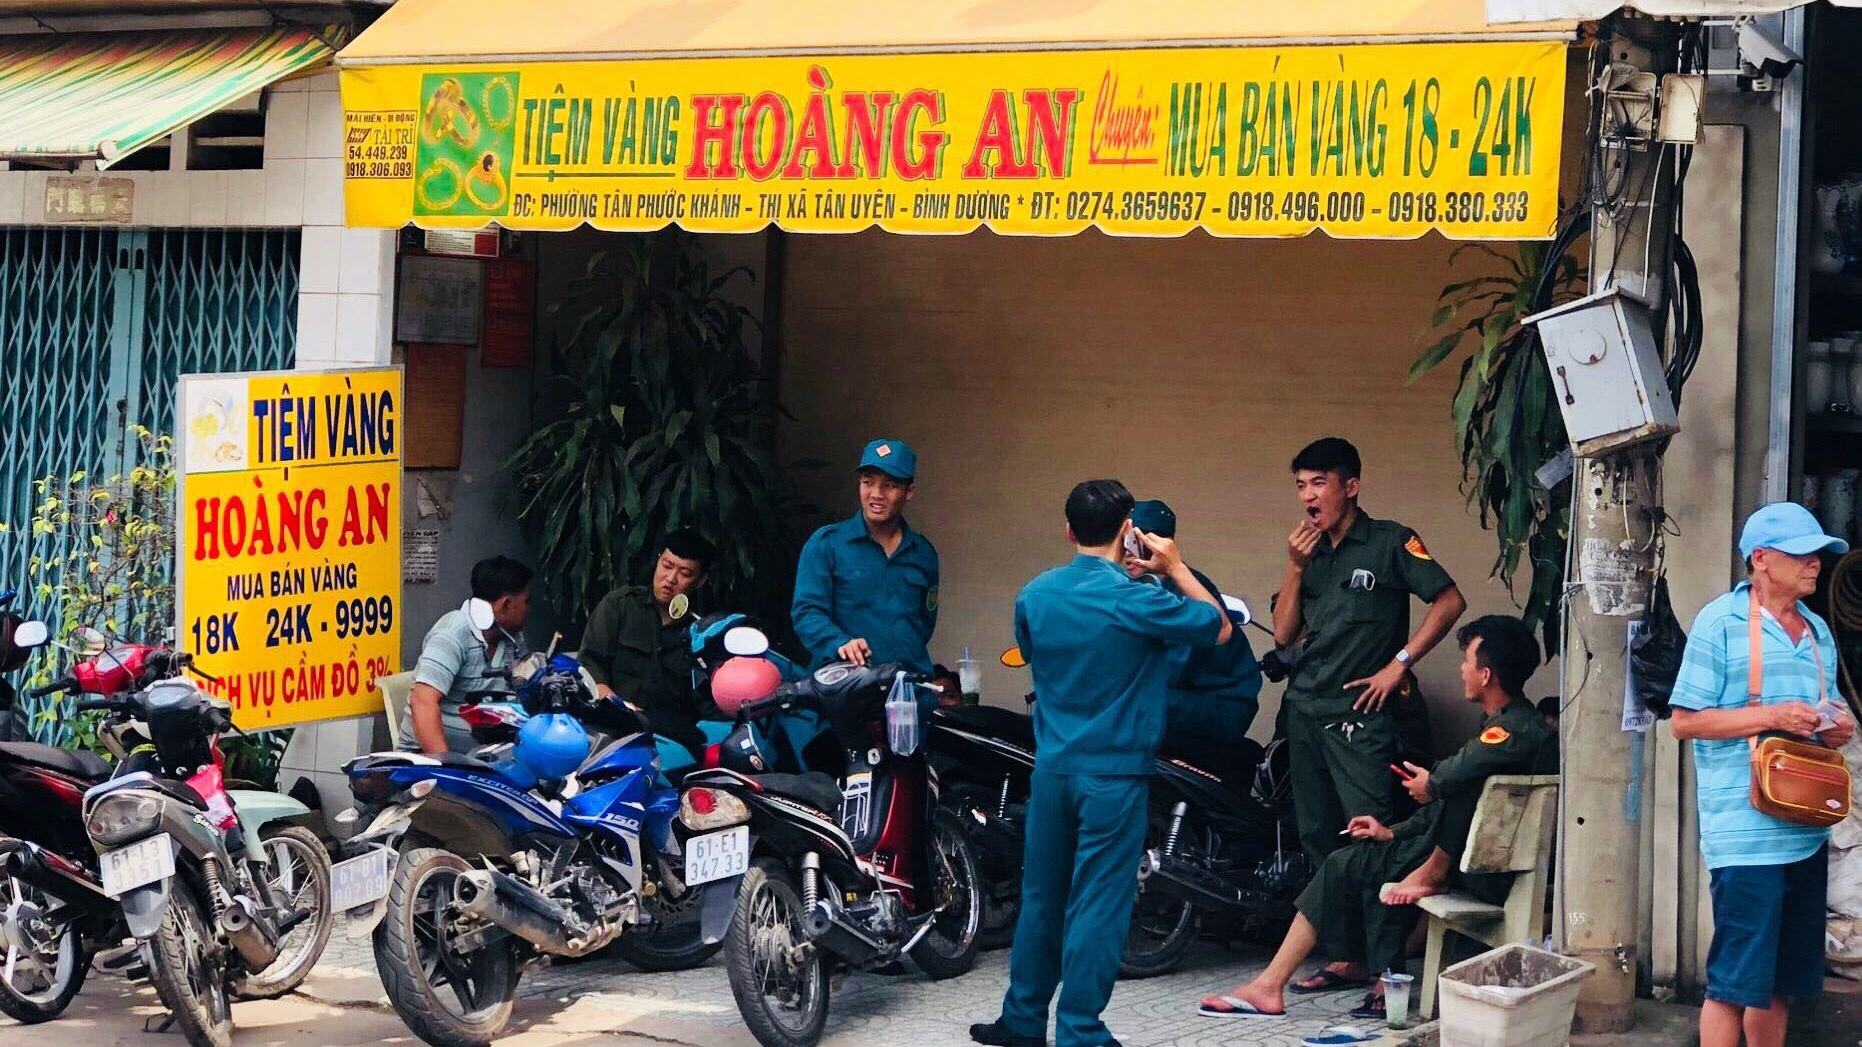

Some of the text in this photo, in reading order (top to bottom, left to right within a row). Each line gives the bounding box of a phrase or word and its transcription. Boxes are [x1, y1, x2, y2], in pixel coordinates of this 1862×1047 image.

[349, 145, 407, 160] 54.449.239
[523, 80, 680, 181] TIỆM VÀNG
[684, 64, 1084, 181] HOÀNG AN
[1164, 81, 1226, 178] MUA
[1236, 55, 1300, 178] BÁN
[1310, 54, 1388, 178] VÀNG
[1402, 77, 1440, 179] 18
[1468, 76, 1537, 177] 24K
[513, 193, 536, 217] ĐC:
[540, 187, 598, 219] PHƯỜNG
[603, 189, 632, 219] TÂN
[636, 187, 687, 219] PHƯỚC
[690, 189, 741, 219] KHÁNH
[759, 193, 782, 223] THỊ
[786, 188, 808, 219] XÃ
[814, 188, 846, 219] TÂN
[850, 189, 897, 220] UYÊN
[913, 188, 951, 220] BÌNH
[955, 188, 1011, 221] DƯƠNG
[1031, 190, 1060, 221] ĐT:
[1066, 190, 1207, 221] 0274.3659637
[1228, 191, 1366, 222] 0918.496.000
[1388, 190, 1530, 222] 0918.380.333
[253, 376, 395, 481] TIỆM VÀNG
[194, 475, 329, 561] HOÀNG
[338, 482, 391, 548] AN
[227, 558, 358, 601] MUA BÁN VÀNG
[192, 611, 240, 656] 18K
[265, 603, 314, 648] 24K
[335, 594, 394, 640] 9999
[196, 675, 242, 710] CH
[248, 669, 275, 719] VỤ
[281, 649, 326, 706] CẦM
[331, 643, 360, 697] ĐỒ
[696, 832, 737, 859] 61-E1
